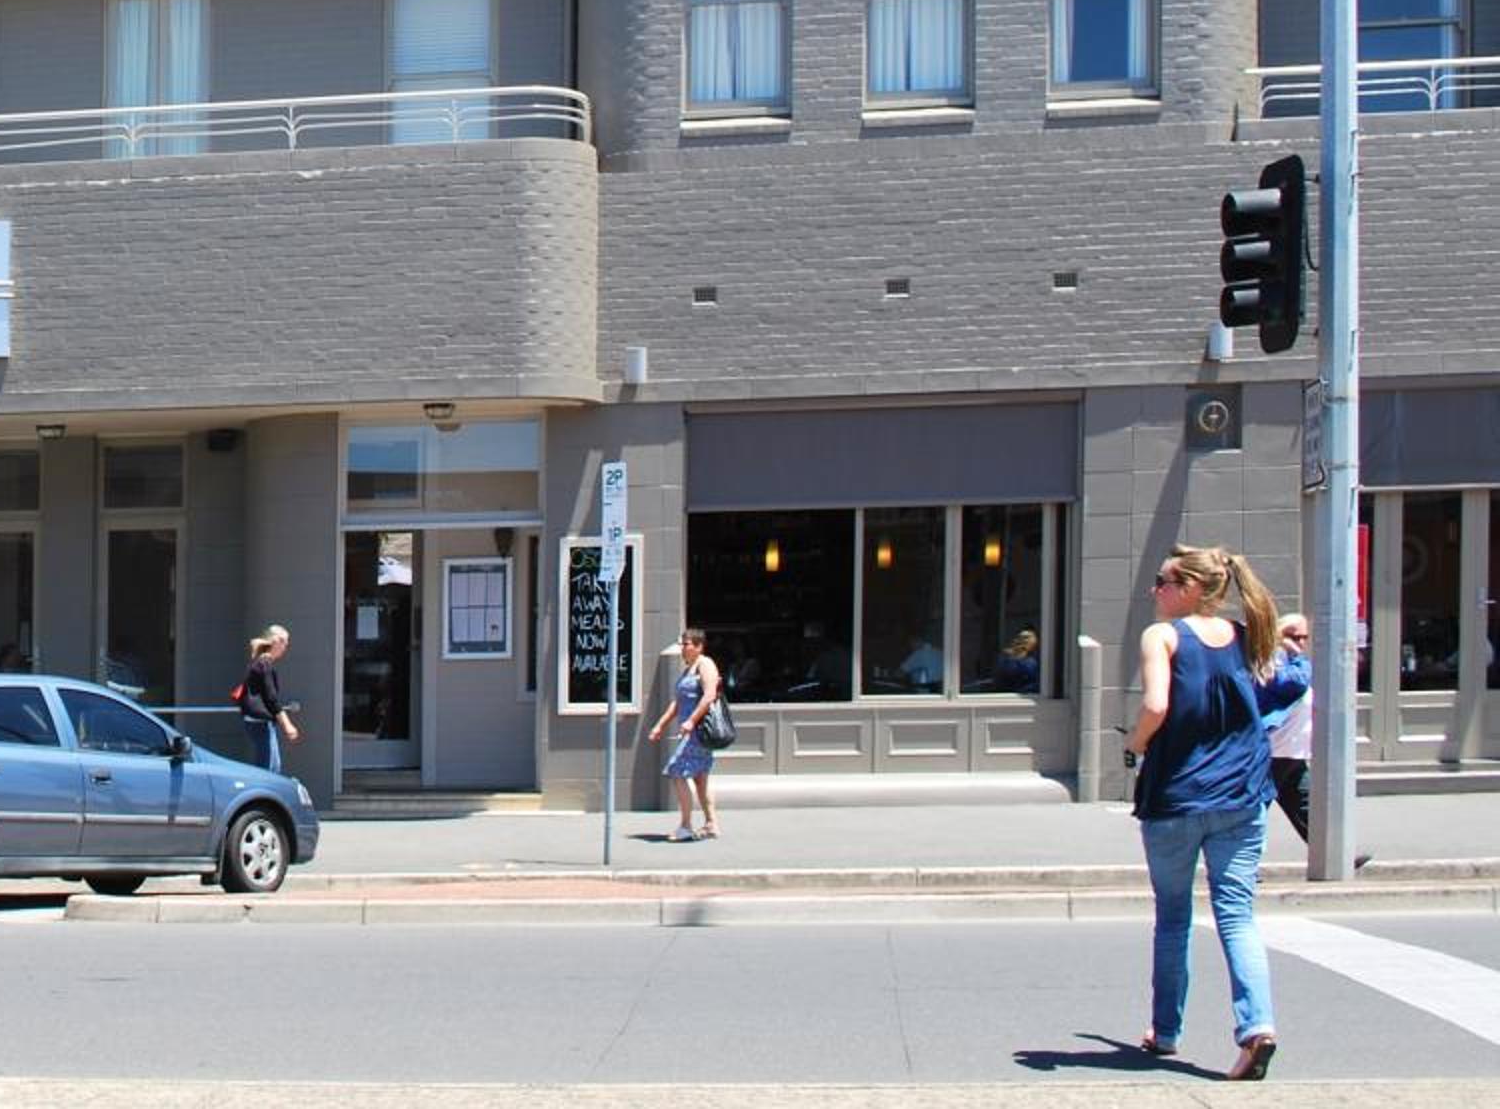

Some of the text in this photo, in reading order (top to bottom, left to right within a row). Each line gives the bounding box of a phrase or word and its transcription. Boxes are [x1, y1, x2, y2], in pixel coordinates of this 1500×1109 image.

[605, 467, 623, 486] 2P
[576, 629, 607, 650] NOW
[572, 652, 629, 673] AVAILABE
